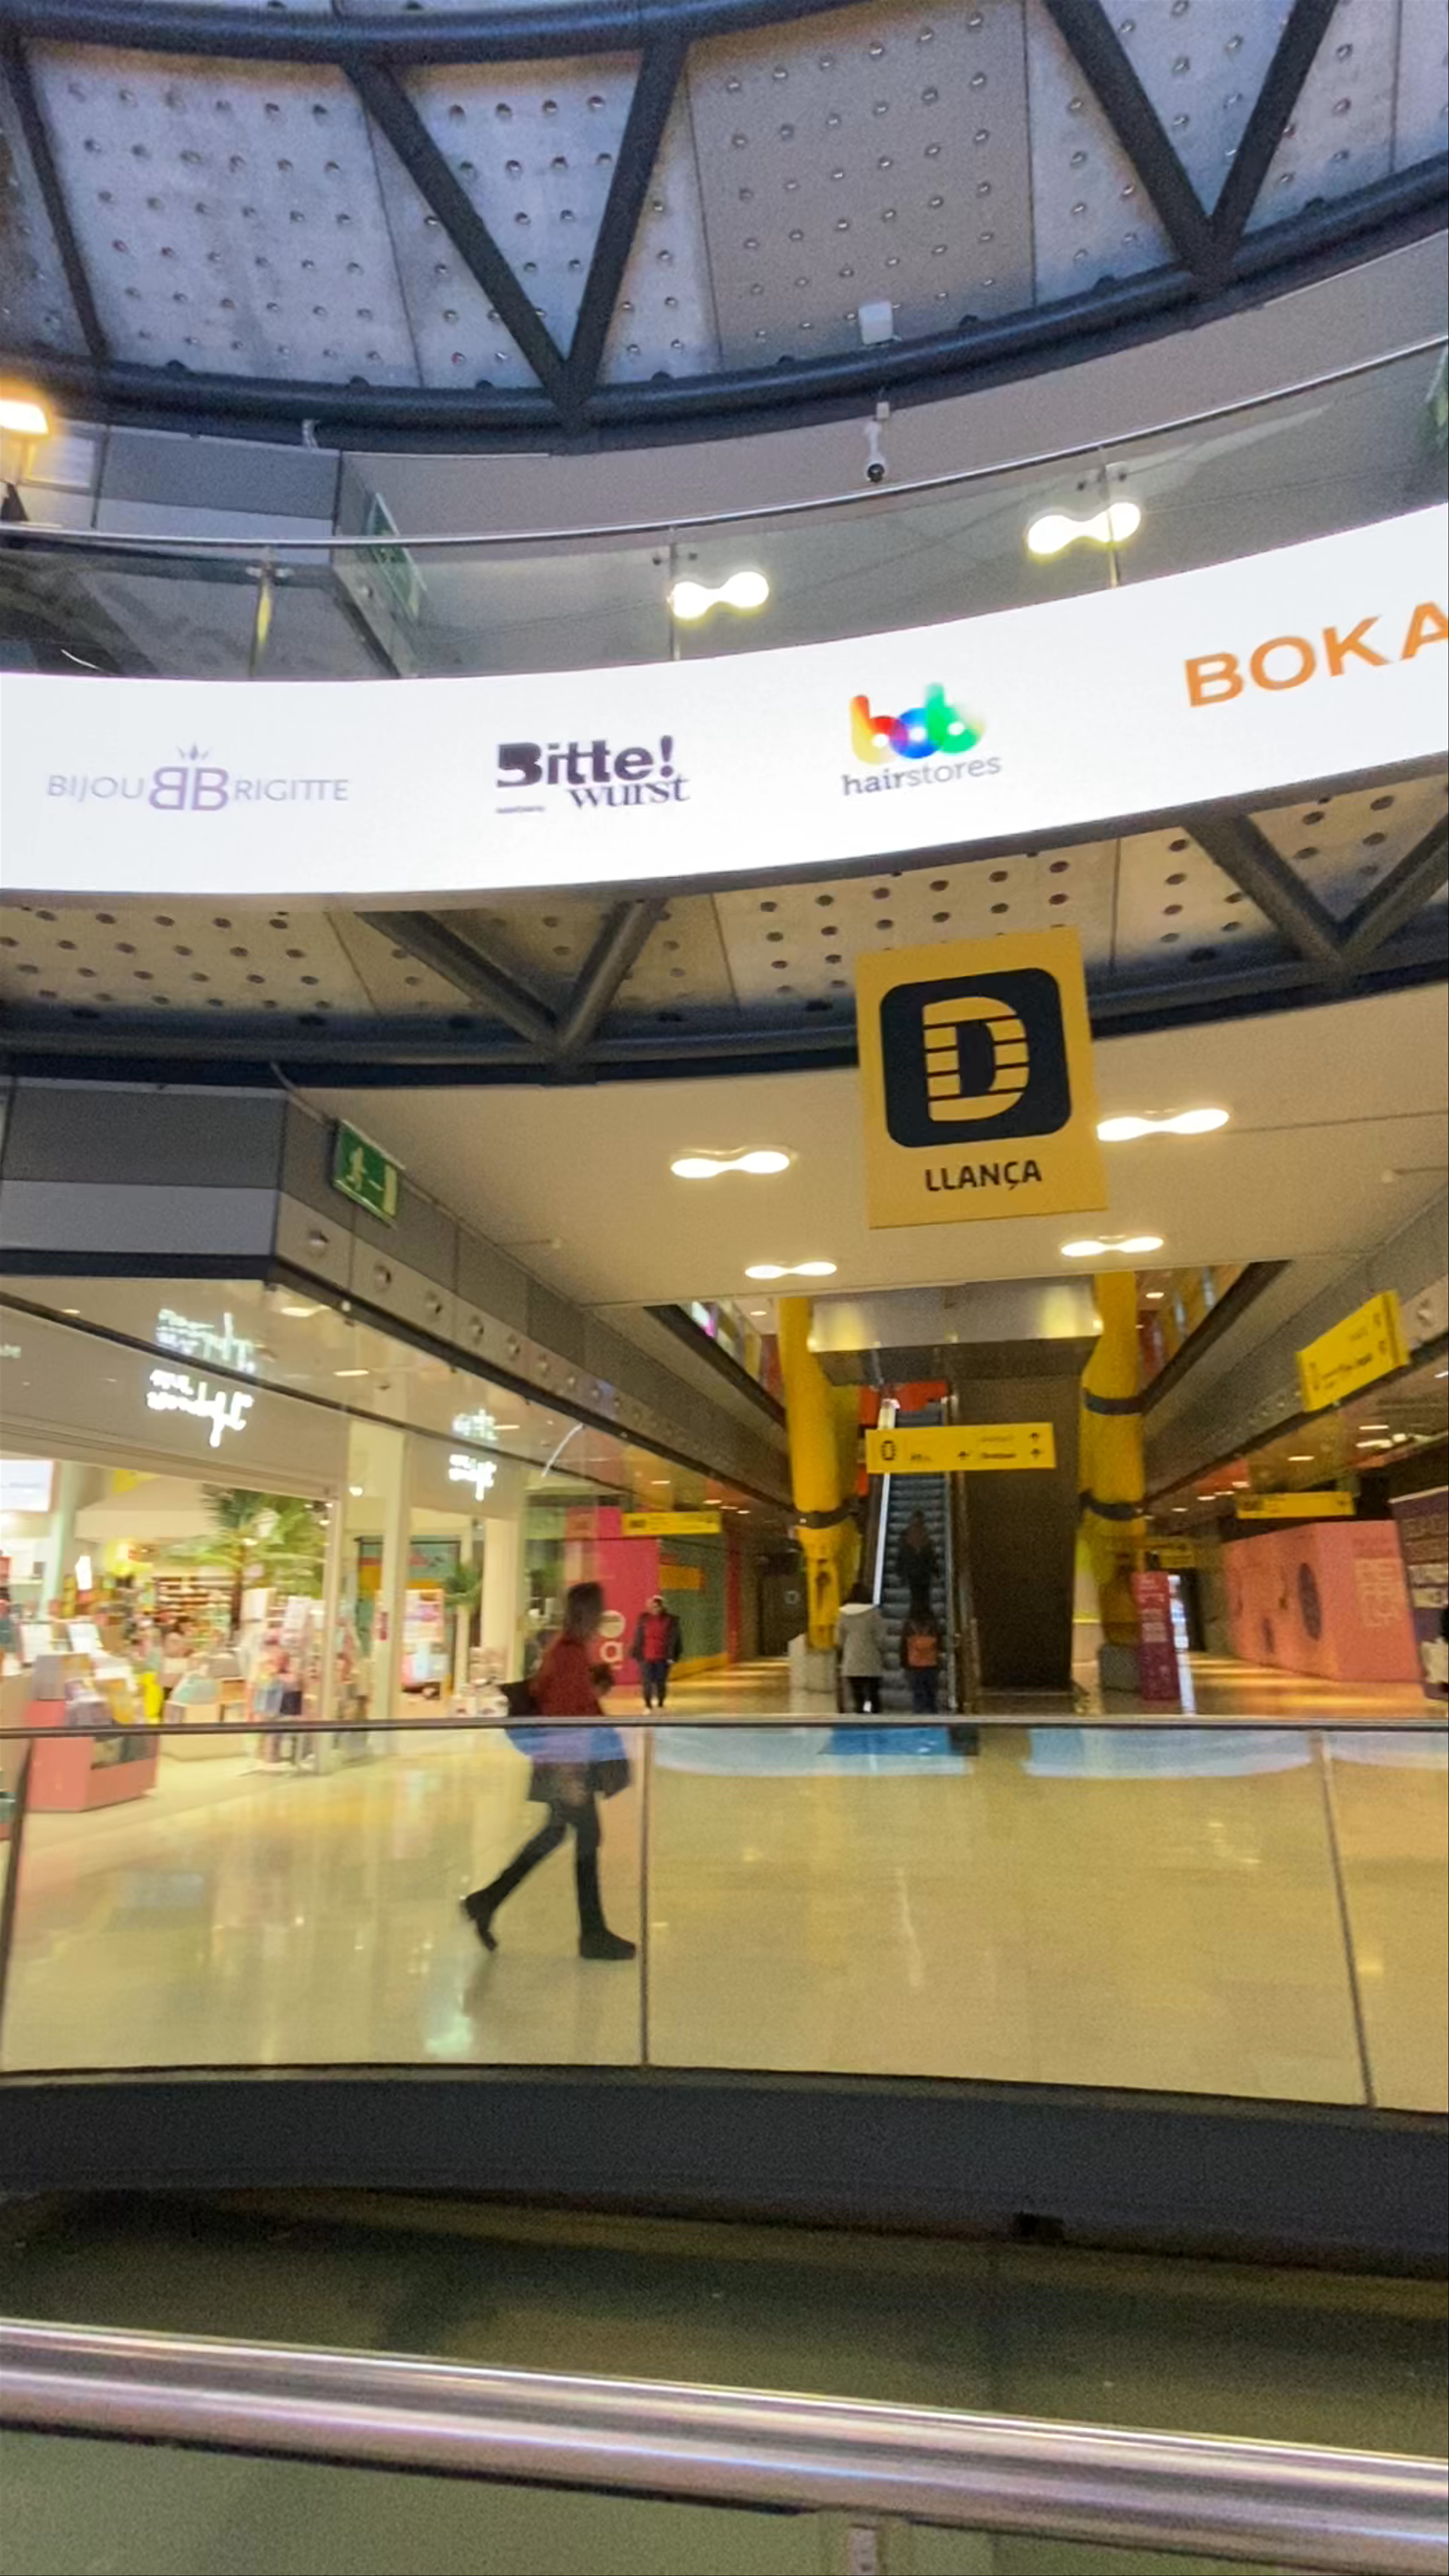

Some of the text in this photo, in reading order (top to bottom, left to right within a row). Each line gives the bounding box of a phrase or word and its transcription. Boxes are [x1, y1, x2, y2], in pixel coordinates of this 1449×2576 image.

[1185, 601, 1449, 707] BOKA
[497, 735, 674, 787] Bitte!
[841, 757, 1002, 795] hairstores
[567, 774, 690, 808] wurst
[923, 996, 1029, 1122] D
[925, 1160, 1042, 1191] LLANÇA
